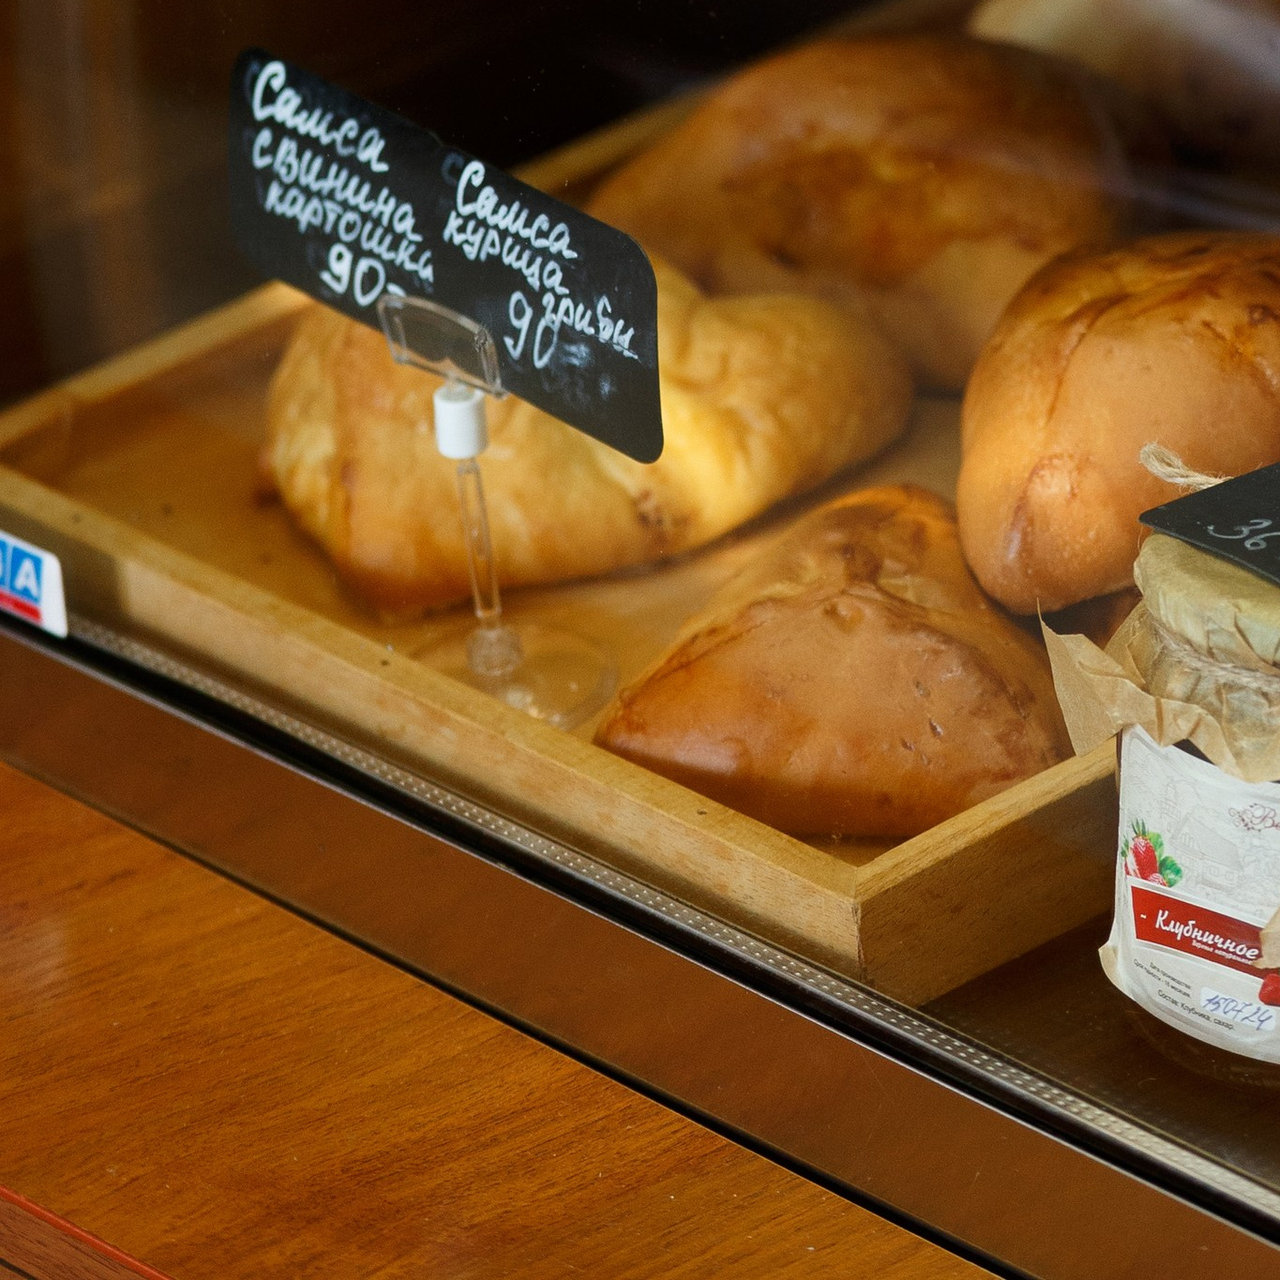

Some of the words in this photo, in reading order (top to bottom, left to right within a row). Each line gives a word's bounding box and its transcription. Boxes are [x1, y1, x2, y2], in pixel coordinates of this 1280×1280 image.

[251, 59, 390, 174] Самса
[443, 208, 570, 295] курица
[455, 159, 578, 260] Самса
[1154, 908, 1261, 961] Клубничное
